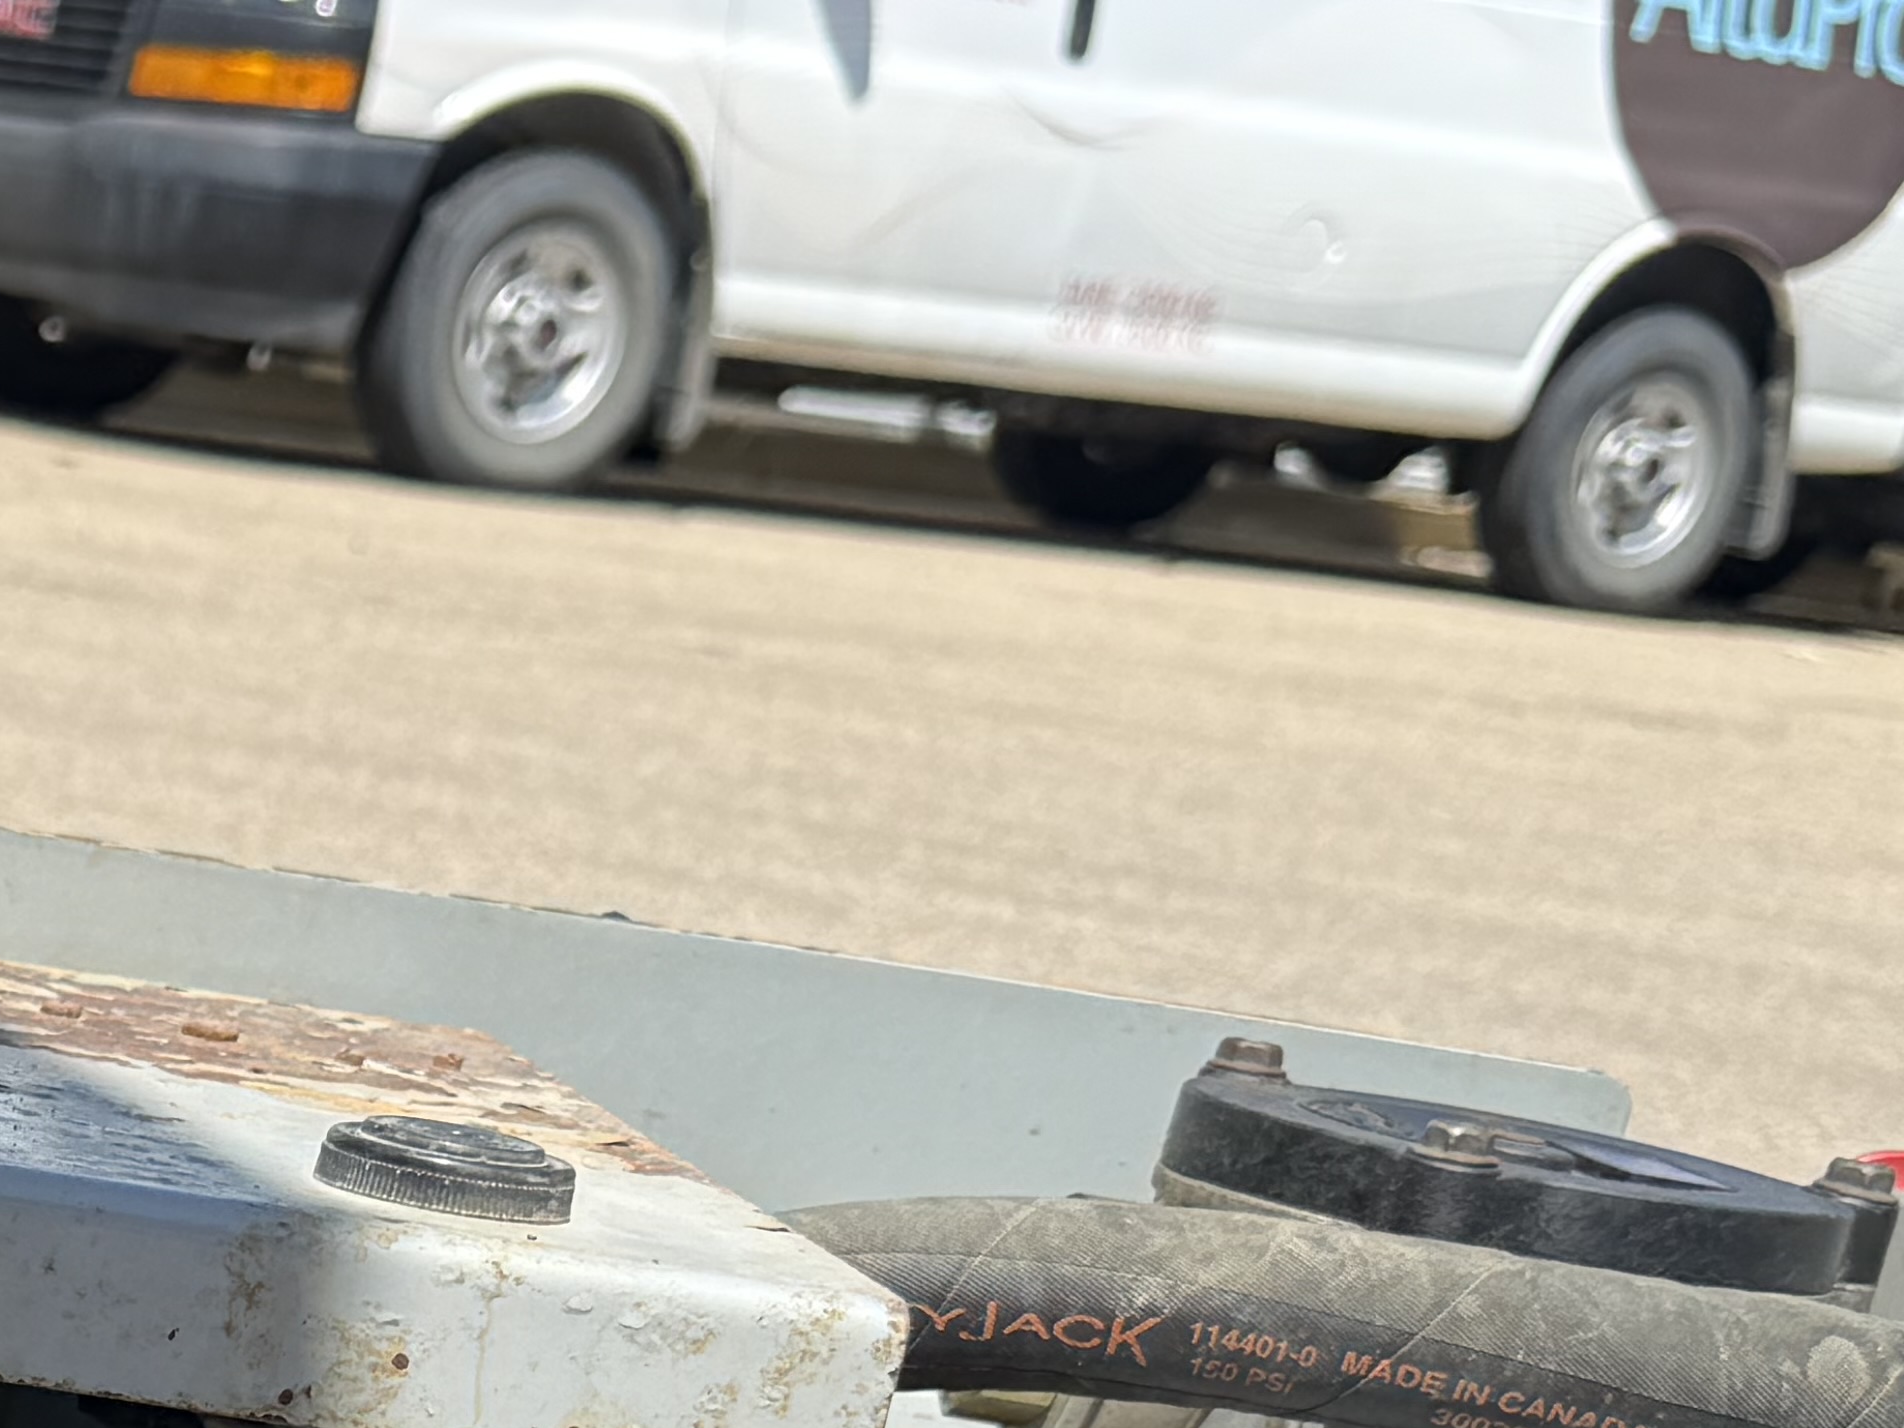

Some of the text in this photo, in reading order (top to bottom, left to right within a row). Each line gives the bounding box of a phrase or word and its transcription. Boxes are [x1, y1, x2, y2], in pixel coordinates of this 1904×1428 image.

[1189, 1356, 1236, 1384] 150
[1190, 1321, 1318, 1371] 114401-0
[1340, 1350, 1449, 1397] MADE
[1452, 1378, 1493, 1405] IN
